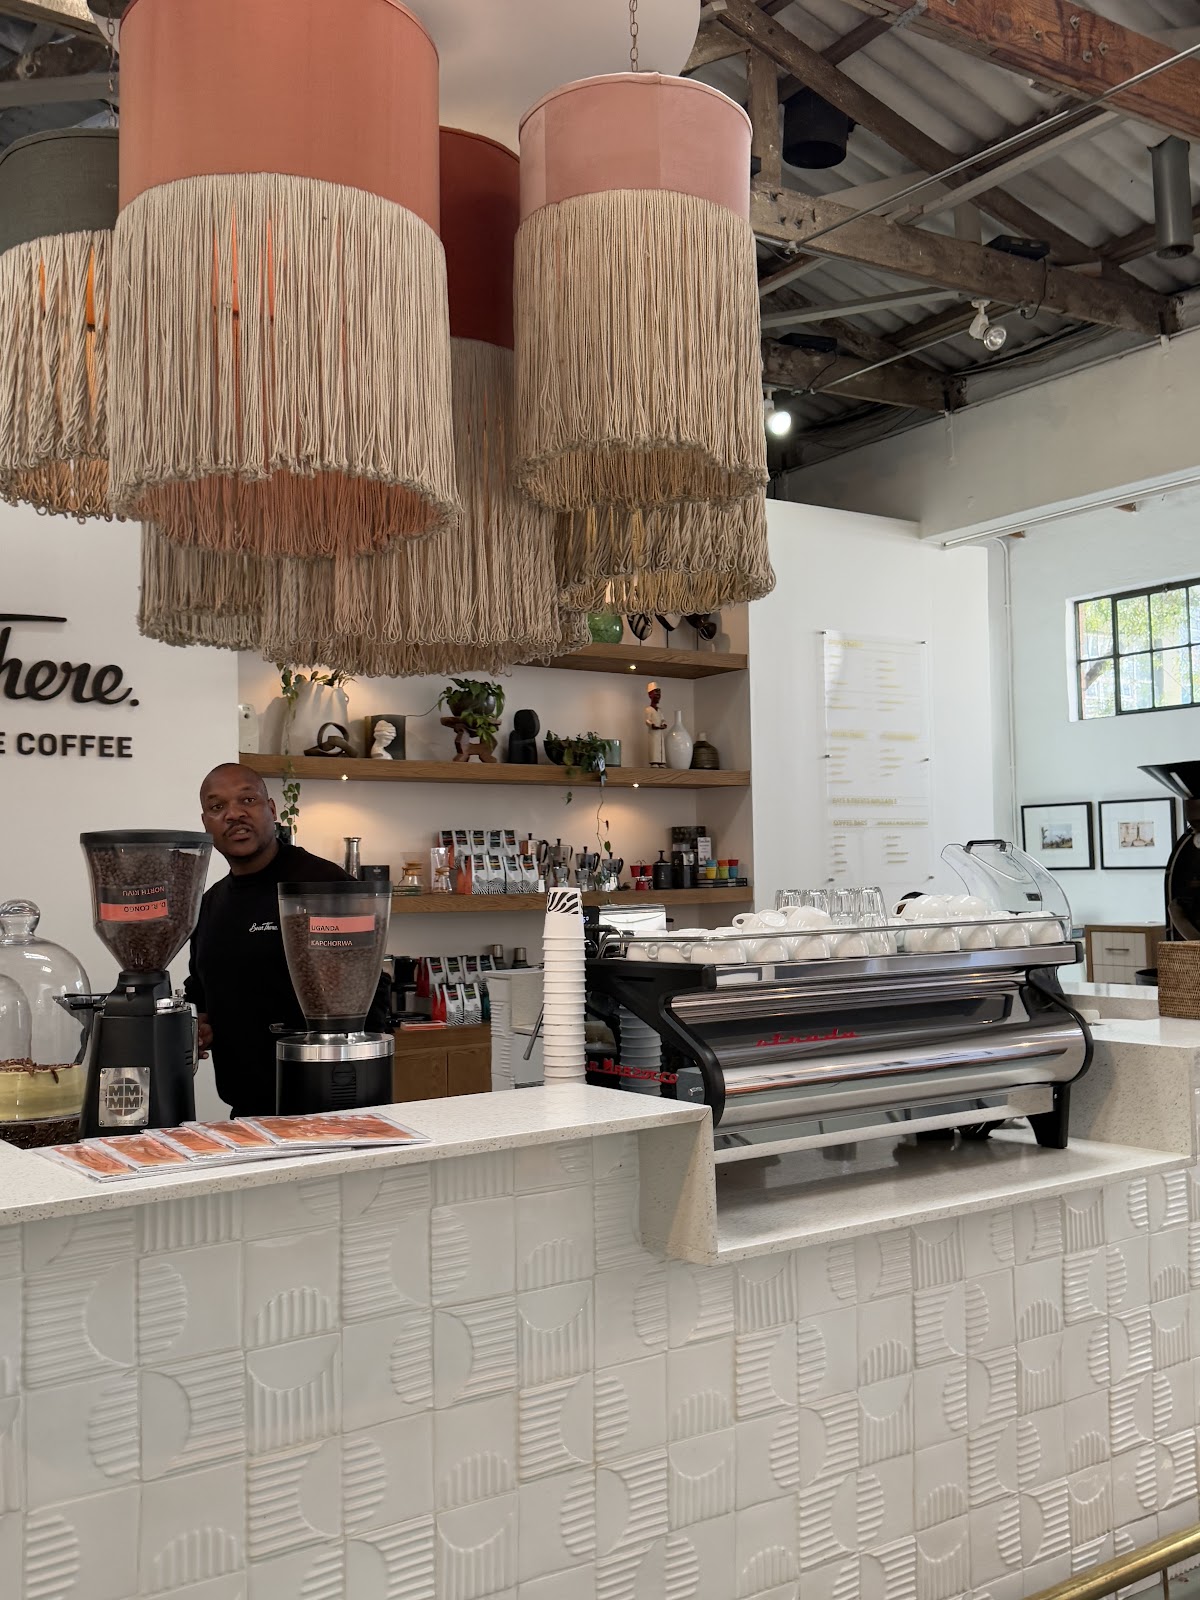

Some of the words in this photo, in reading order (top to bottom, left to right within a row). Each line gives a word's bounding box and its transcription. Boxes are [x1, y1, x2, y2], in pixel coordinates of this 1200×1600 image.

[0, 614, 140, 707] here.
[16, 732, 134, 758] COFFEE
[141, 886, 165, 895] NORTH
[123, 905, 150, 913] CONGO
